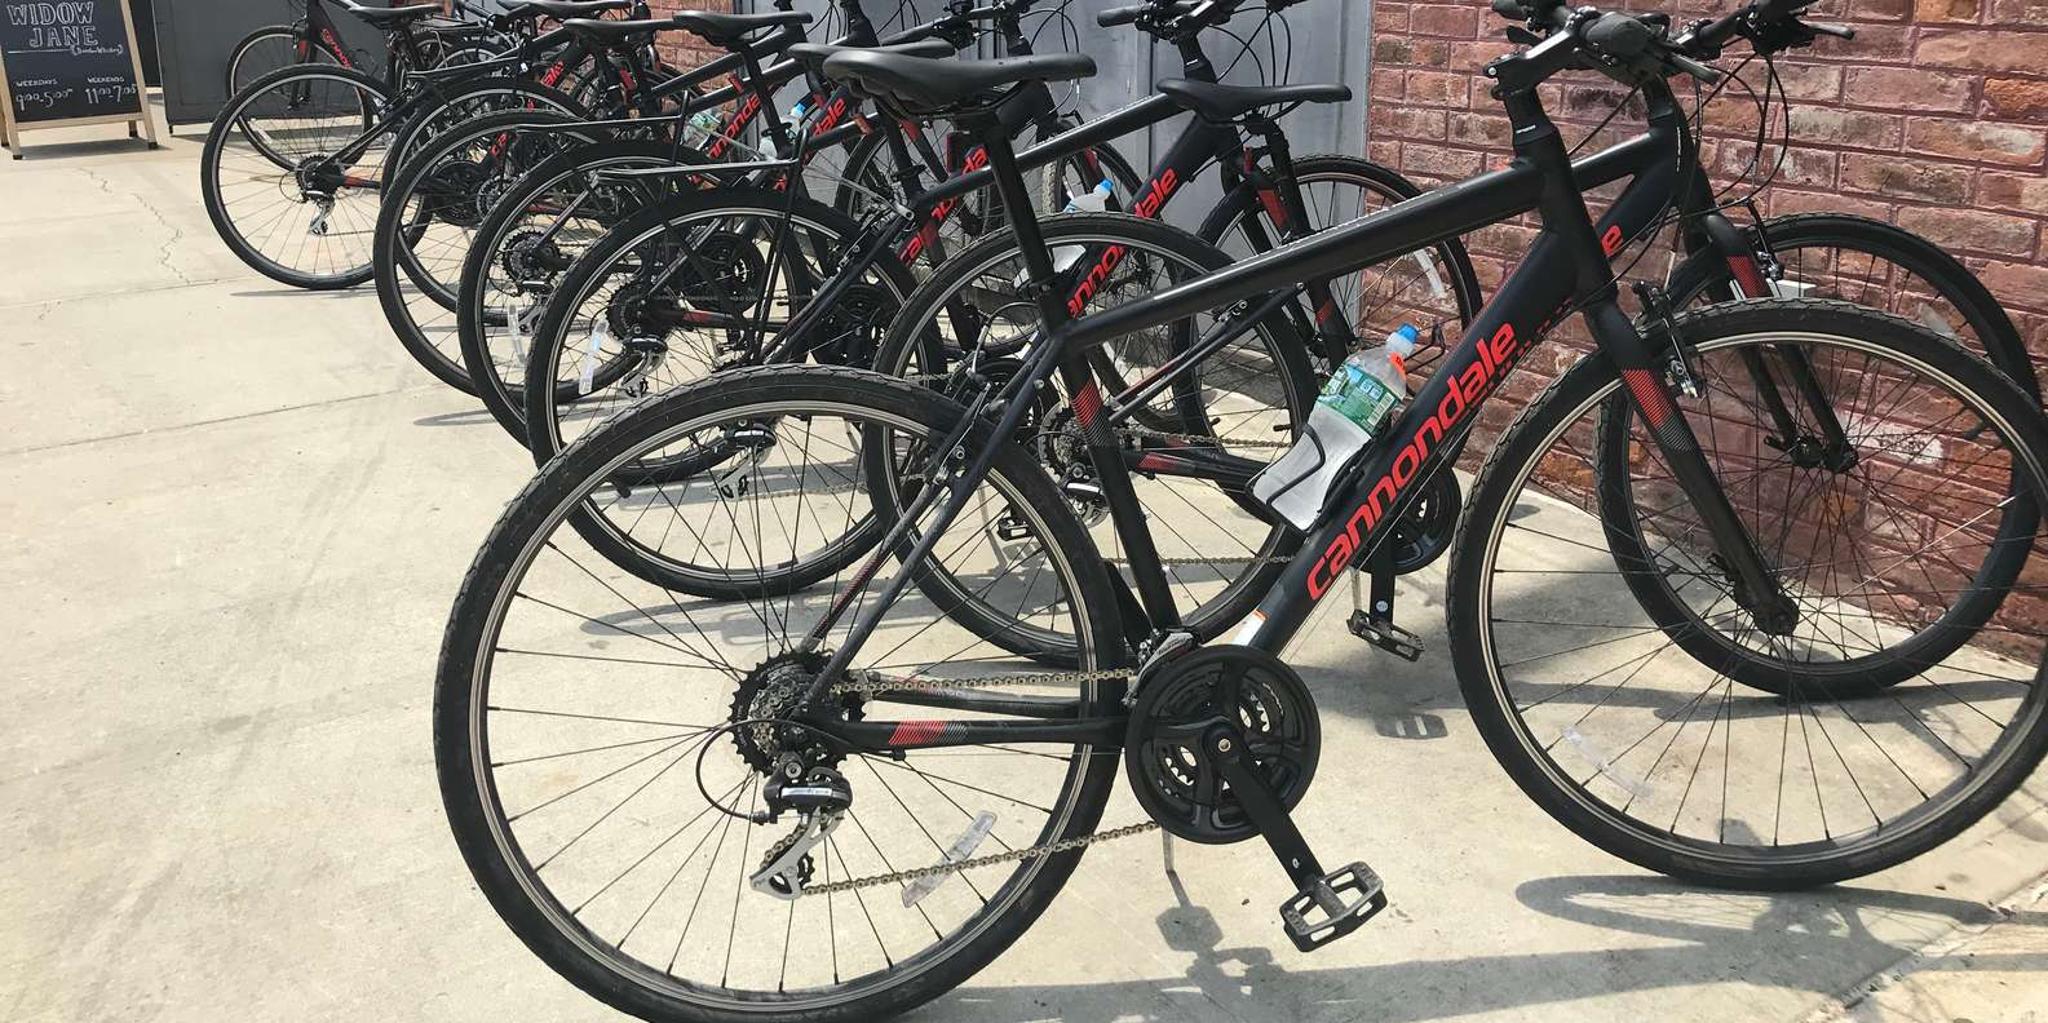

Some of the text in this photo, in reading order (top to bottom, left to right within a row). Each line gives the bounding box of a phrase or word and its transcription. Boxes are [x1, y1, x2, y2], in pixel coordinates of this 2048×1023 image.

[6, 1, 94, 25] WIDOW
[29, 26, 99, 48] JANE
[1306, 321, 1520, 601] cannondale
